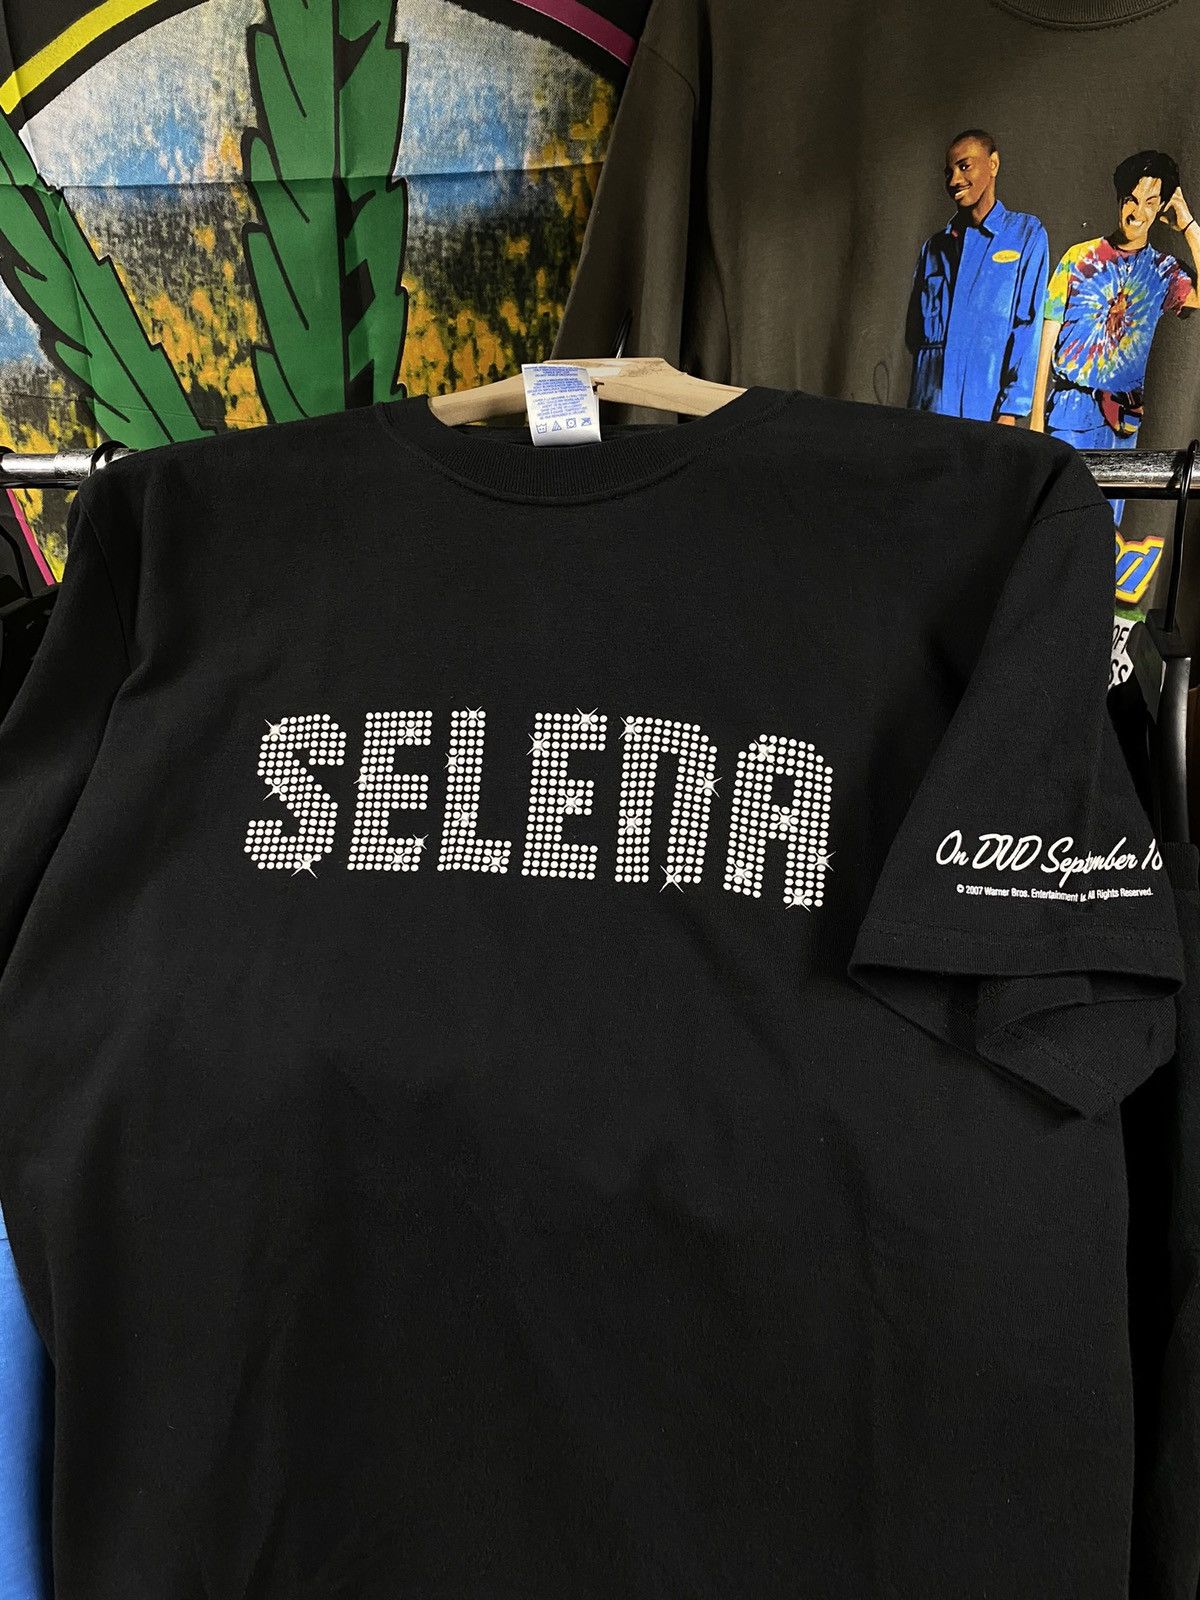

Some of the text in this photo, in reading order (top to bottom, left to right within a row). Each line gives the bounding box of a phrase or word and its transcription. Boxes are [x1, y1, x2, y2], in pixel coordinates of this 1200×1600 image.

[244, 707, 834, 910] SELENA
[936, 830, 969, 866] On
[972, 834, 1042, 871] DVD
[1041, 836, 1138, 889] Septmber
[965, 885, 983, 895] 2007
[984, 886, 1010, 897] Warner
[1011, 887, 1030, 898] Bros.
[1031, 888, 1078, 902] Entertainment
[1087, 889, 1095, 900] All
[1096, 888, 1119, 900] Rights
[1120, 887, 1153, 897] Reserved.
